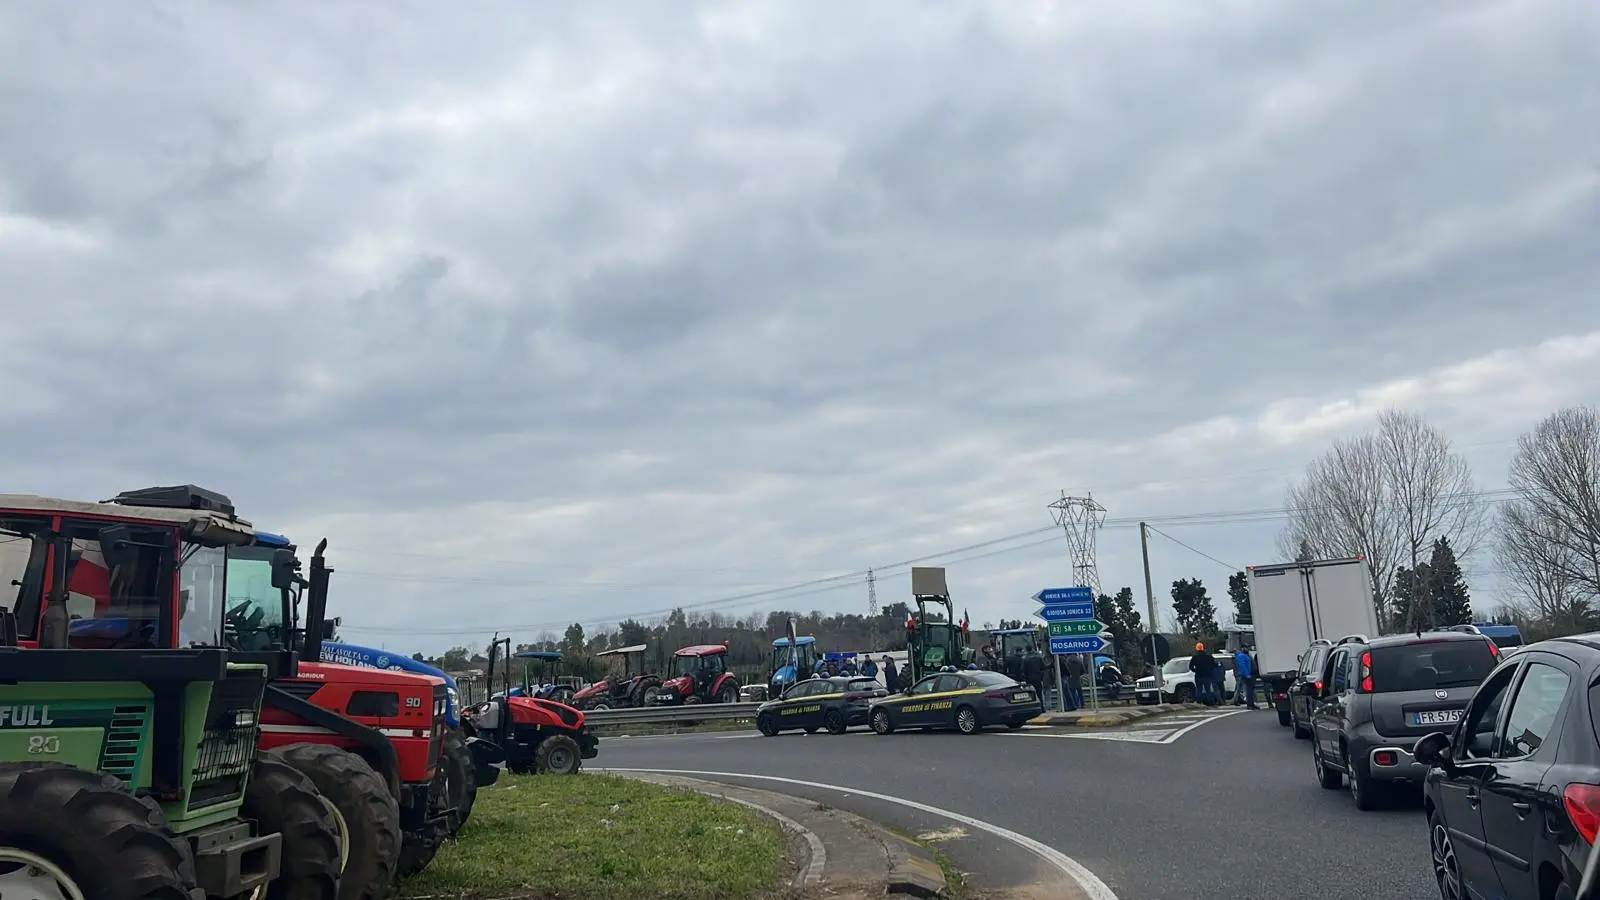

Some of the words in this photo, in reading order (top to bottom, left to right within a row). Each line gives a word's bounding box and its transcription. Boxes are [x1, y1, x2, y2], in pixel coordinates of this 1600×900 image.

[1077, 624, 1086, 632] RC
[1052, 641, 1090, 649] ROSARNO
[319, 651, 334, 661] EW
[321, 645, 361, 660] MALAVOLTA
[405, 697, 421, 707] 90
[902, 705, 923, 713] GUARDIA
[924, 703, 930, 711] di
[930, 701, 952, 710] FINANZA
[781, 707, 798, 716] GUARDIA
[803, 704, 821, 713] FINANZA
[0, 705, 54, 727] FULL
[1421, 712, 1435, 723] FR
[28, 735, 61, 754] 80
